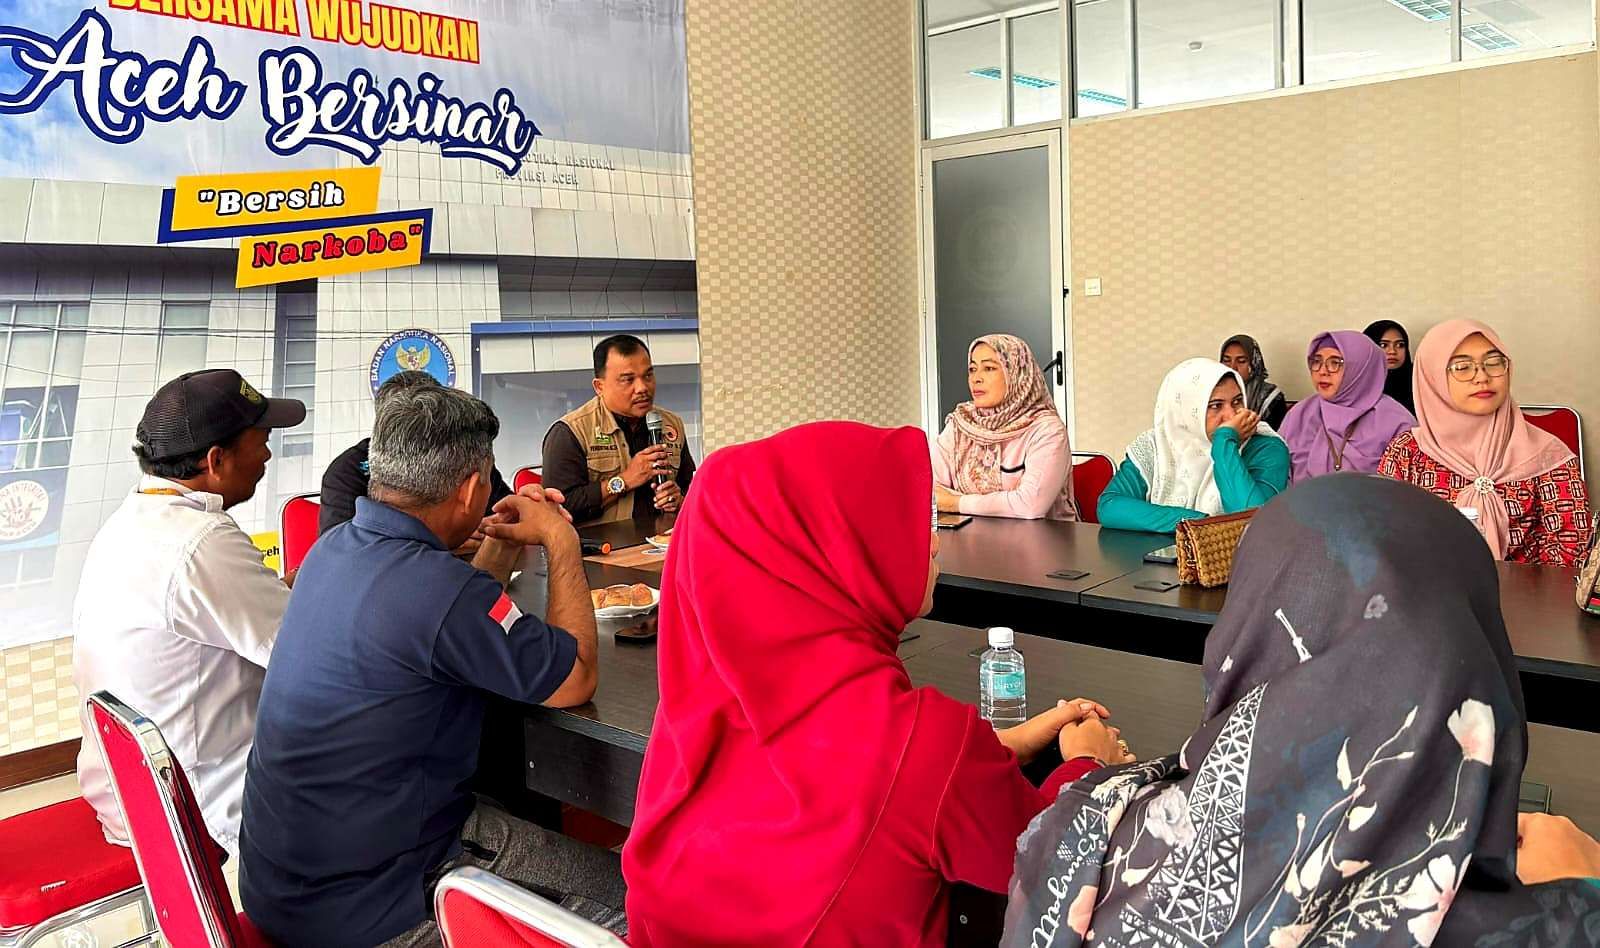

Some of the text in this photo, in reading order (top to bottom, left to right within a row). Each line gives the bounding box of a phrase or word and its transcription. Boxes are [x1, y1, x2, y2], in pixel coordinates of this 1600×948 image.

[306, 0, 479, 63] WUJUDKAN
[0, 9, 535, 172] Aceh Bersinar
[199, 182, 344, 215] "Bersih
[371, 348, 385, 381] BADAN
[430, 335, 456, 377] NASIONAL
